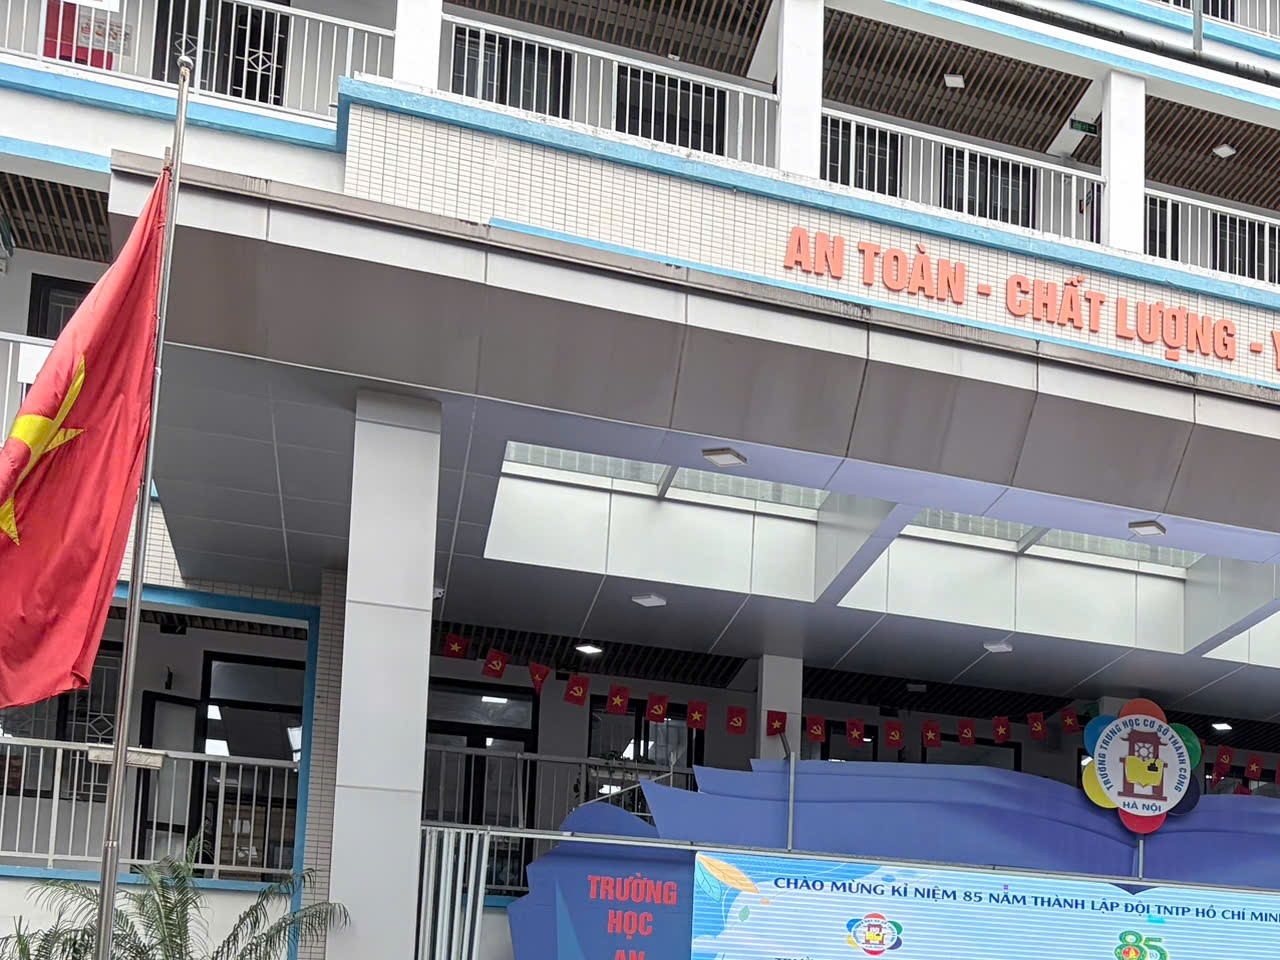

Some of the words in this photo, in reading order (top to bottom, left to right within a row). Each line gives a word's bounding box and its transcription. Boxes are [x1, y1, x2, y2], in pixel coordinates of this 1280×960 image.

[784, 226, 844, 280] AN
[858, 243, 966, 305] TOÀN
[1007, 273, 1106, 333] CHẤT
[1116, 297, 1237, 361] LƯỢNG
[1100, 724, 1122, 751] TRUNG
[1122, 718, 1141, 729] HỌC
[1122, 800, 1138, 810] HÀ
[1141, 802, 1162, 813] NỘI
[587, 873, 678, 905] TRƯỜNG
[773, 875, 824, 891] CHÀO
[830, 879, 885, 896] MỪNG
[891, 883, 908, 897] KỈ
[913, 886, 957, 902] NIỆM
[963, 890, 983, 903] 85
[988, 890, 1027, 906] NĂM
[1031, 894, 1086, 910] THÀNH
[1091, 898, 1120, 914] LẬP
[1124, 901, 1150, 917] ĐỘI
[1154, 903, 1191, 916] TNTP
[1221, 906, 1246, 921] CHÍ
[607, 910, 653, 940] HỌC
